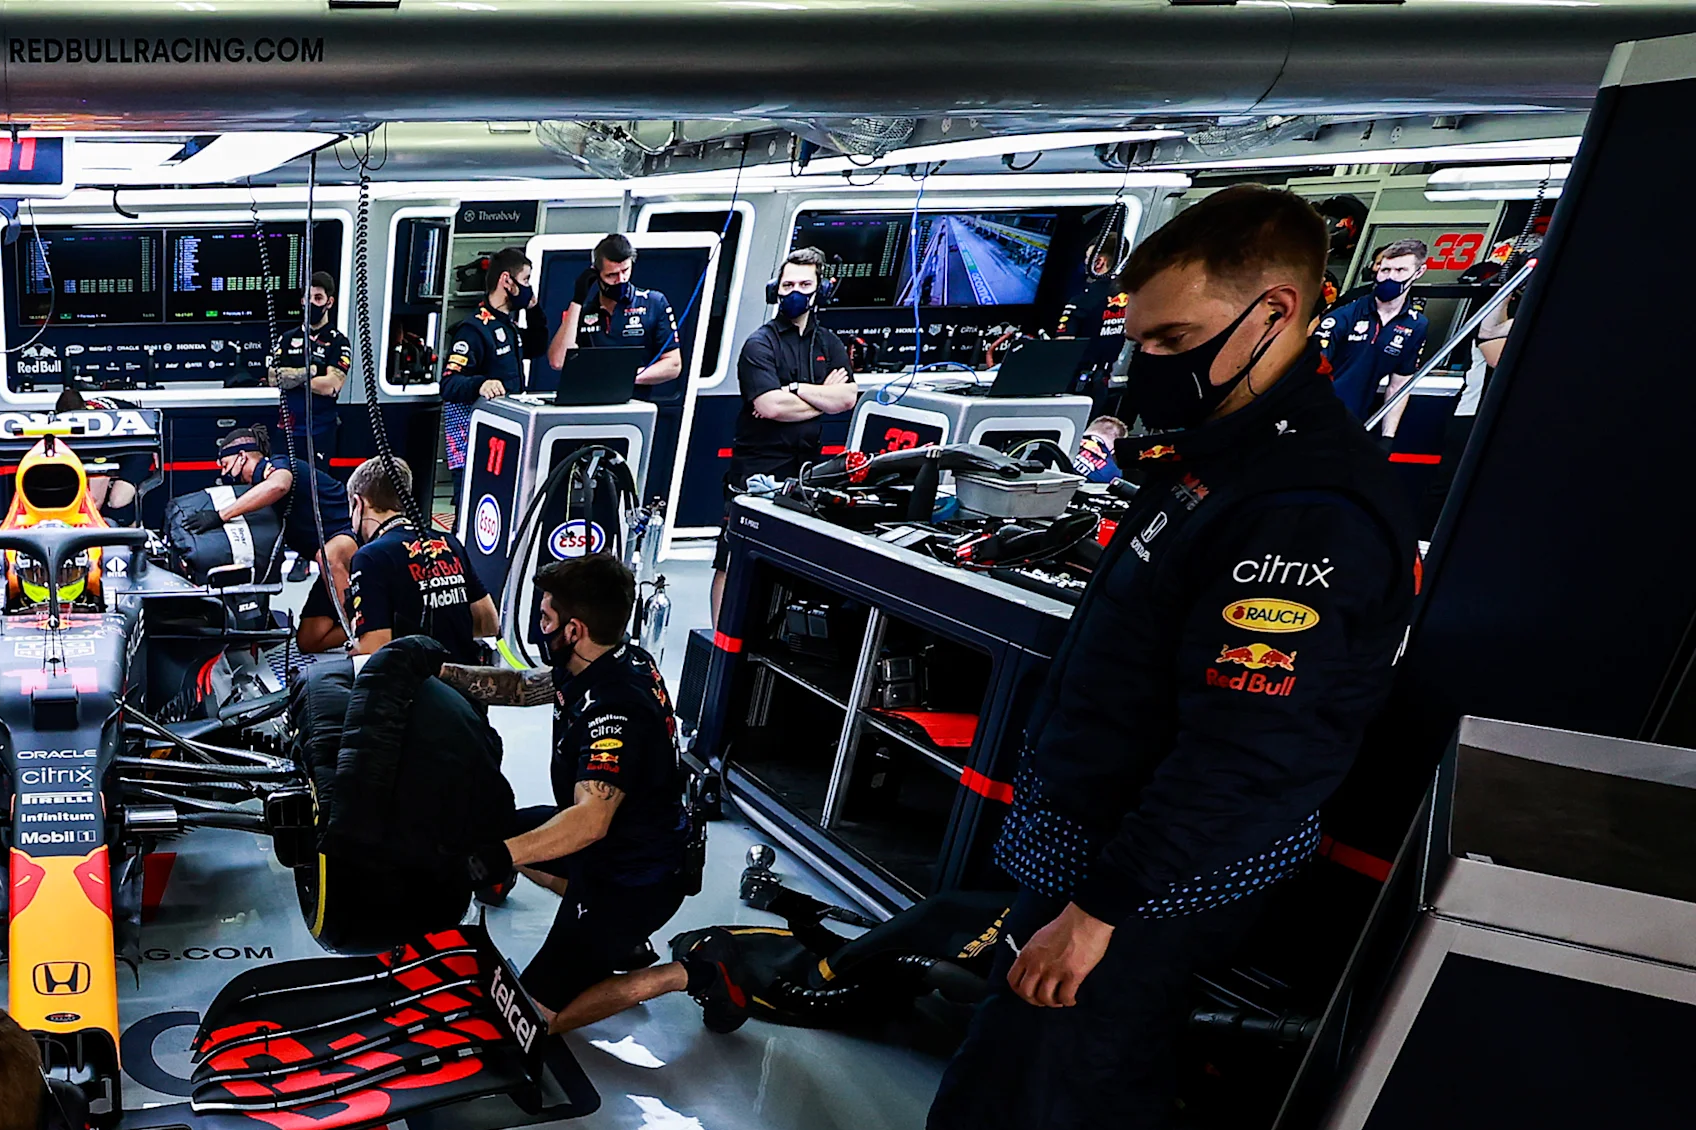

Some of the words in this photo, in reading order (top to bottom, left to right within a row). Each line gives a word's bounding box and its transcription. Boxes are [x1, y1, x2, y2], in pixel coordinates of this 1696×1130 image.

[9, 37, 324, 64] REDBULLRACING.COM
[478, 210, 521, 223] Therabody
[1425, 233, 1485, 271] 33
[244, 341, 262, 350] citrix
[17, 361, 41, 374] Red
[41, 360, 62, 373] Bull
[486, 436, 506, 476] 11
[1232, 554, 1335, 588] citrix
[1245, 607, 1308, 625] RAUCH
[1206, 668, 1248, 692] Red
[1246, 673, 1297, 697] Bull
[590, 724, 623, 739] citrix
[17, 749, 97, 759] ORACLE
[22, 766, 94, 785] citrix
[21, 791, 94, 805] PIRELLI
[21, 831, 75, 844] Mobil
[490, 966, 538, 1054] telcel
